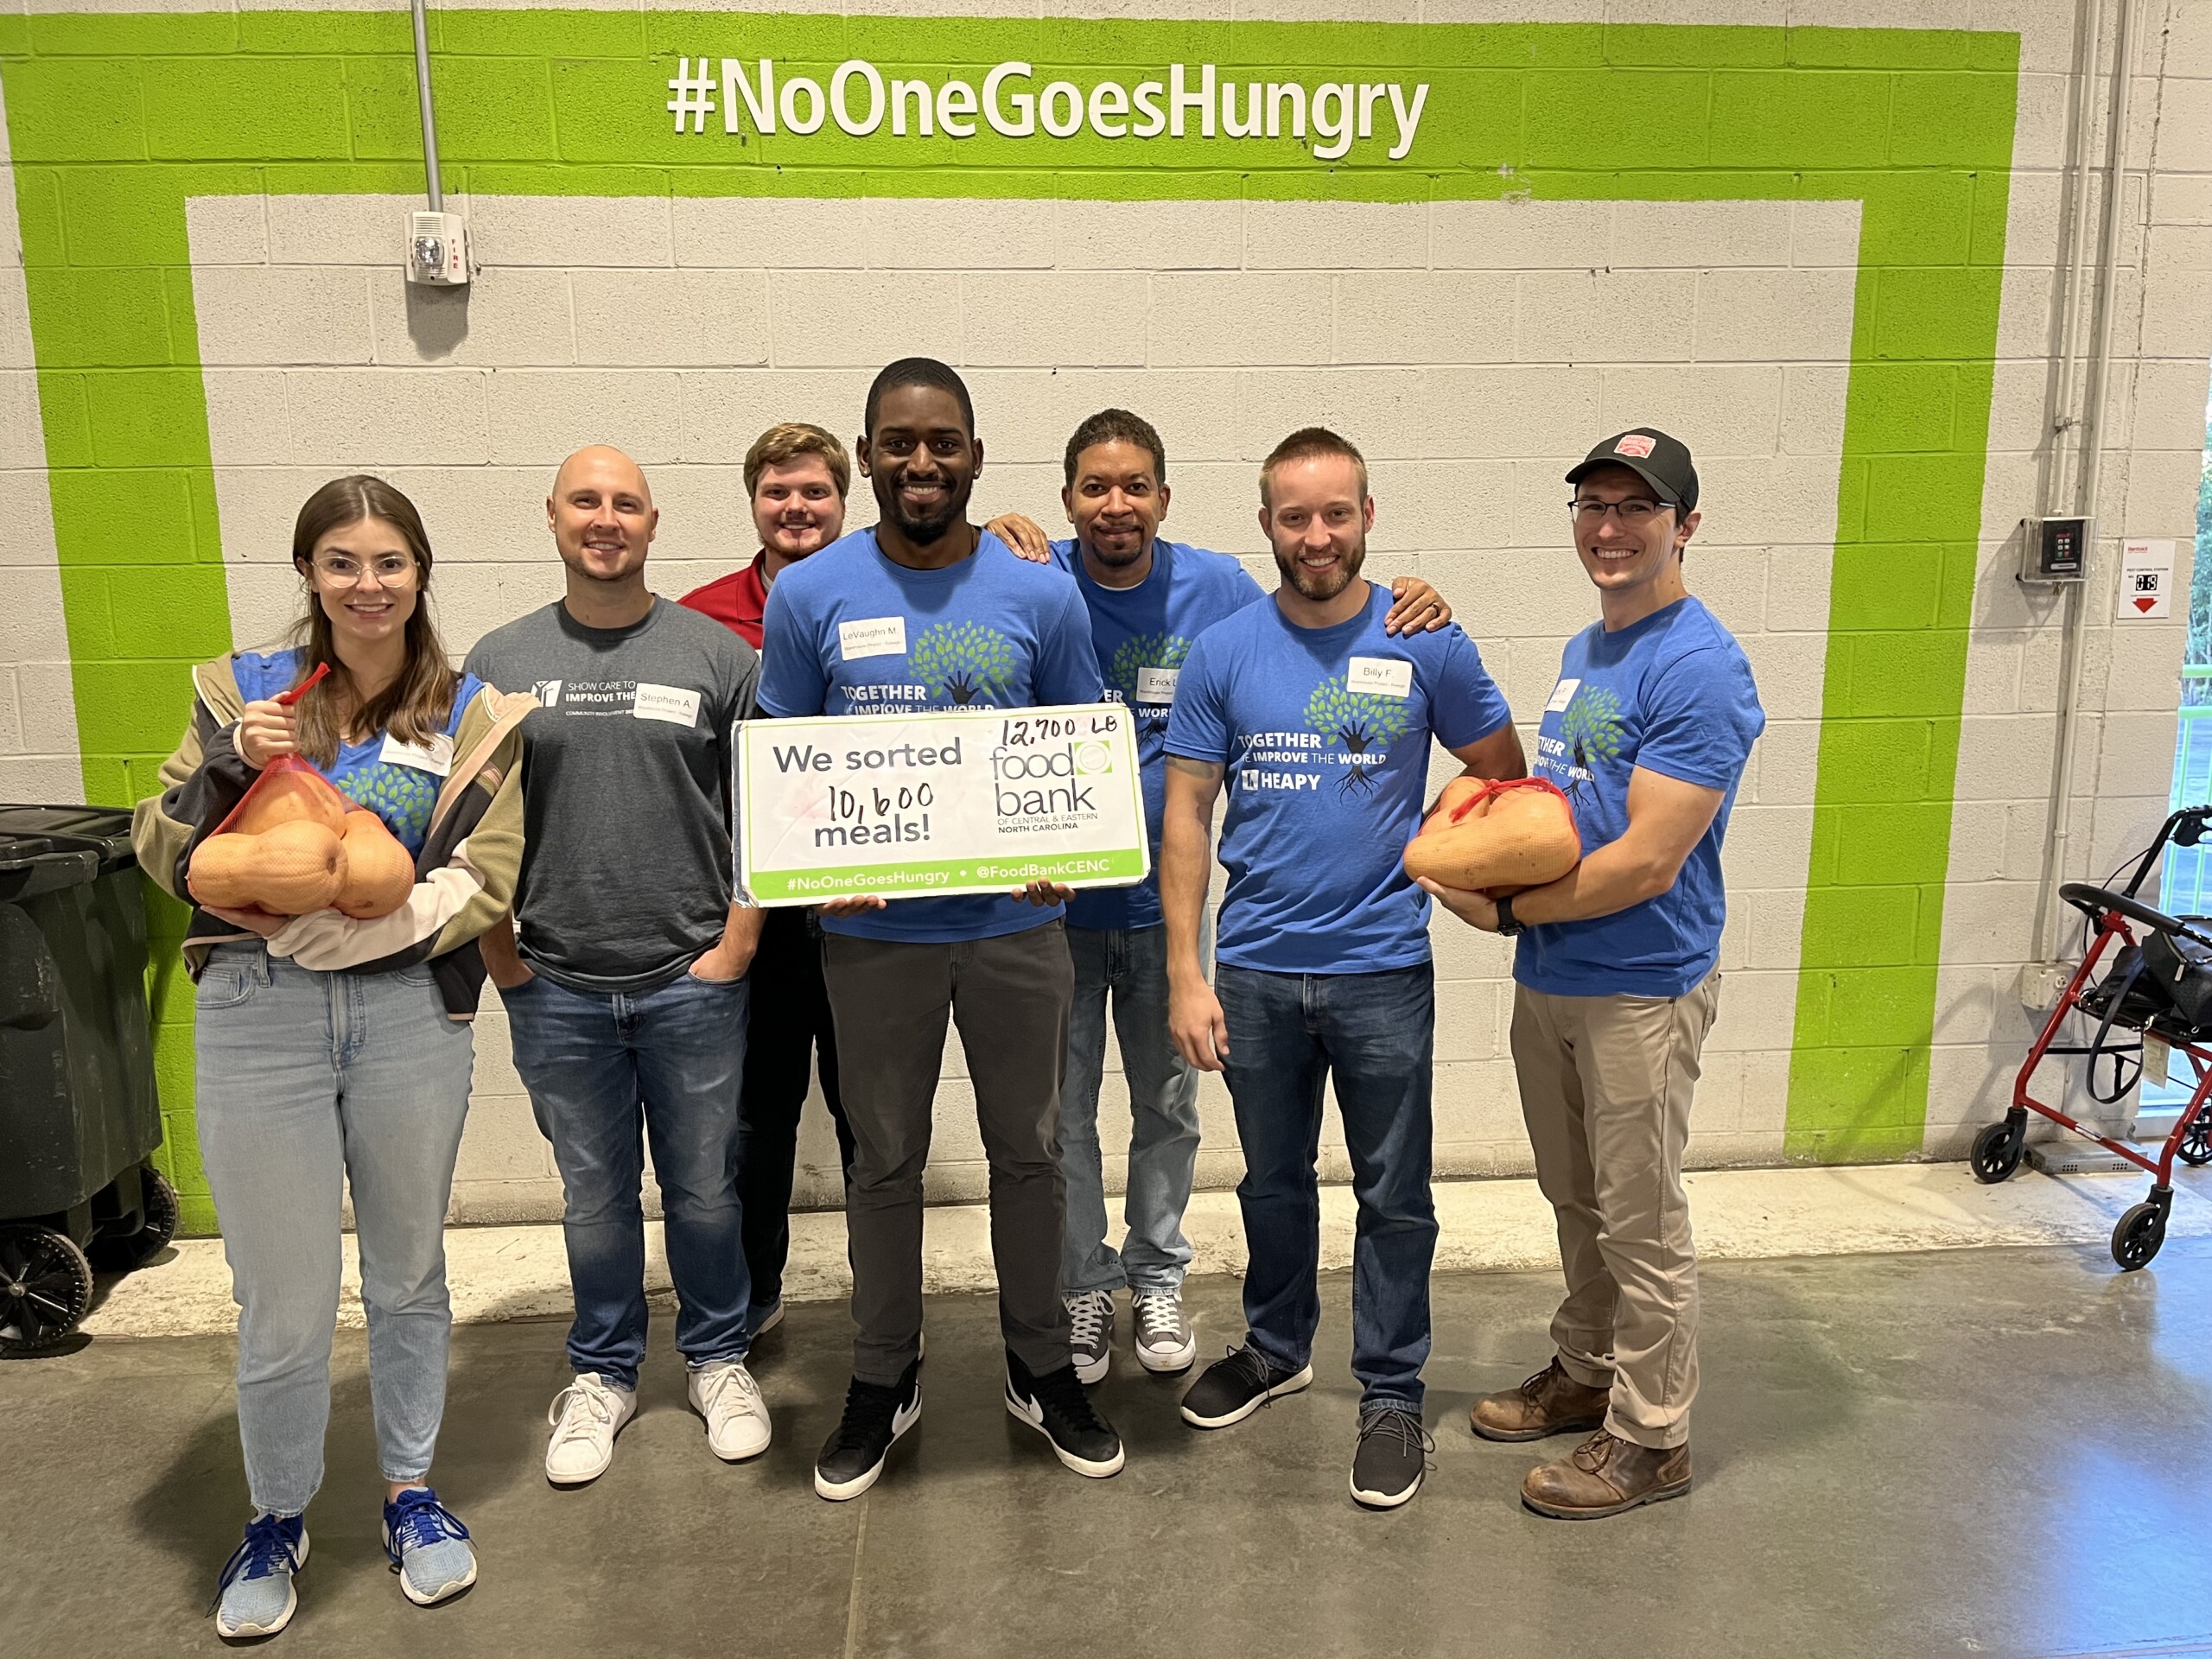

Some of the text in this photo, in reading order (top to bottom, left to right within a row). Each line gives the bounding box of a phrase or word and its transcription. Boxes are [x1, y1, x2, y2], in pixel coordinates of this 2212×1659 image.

[667, 57, 1430, 159] #NoOneGoesHungry
[2137, 575, 2157, 590] 019
[842, 628, 886, 640] LeVaughn
[1363, 667, 1383, 679] Billy
[568, 680, 636, 691] SHOW CARE TO
[1149, 677, 1171, 687] Erick
[565, 691, 636, 702] IMPROVE THE
[640, 692, 681, 705] Stephen
[841, 684, 927, 701] TOGETHER
[1138, 708, 1170, 718] WOR
[1090, 715, 1117, 734] LB
[1237, 732, 1322, 749] TOGETHER
[772, 736, 962, 772] We sorted
[989, 742, 1075, 780] food
[1252, 751, 1308, 764] IMPROVE
[1311, 753, 1335, 765] THE
[1338, 753, 1387, 766] WORLD
[1549, 758, 1568, 775] THE
[1261, 772, 1321, 790] HEAPY
[828, 782, 934, 824] 10,600
[995, 778, 1096, 817] bank
[997, 817, 1009, 826] OF
[1011, 815, 1049, 825] CENTRAL
[1061, 812, 1098, 822] EASTERN
[815, 813, 931, 848] meals!
[998, 822, 1079, 834] NORTH CAROLINA
[787, 858, 1110, 892] #NoOneGoesHungry @FoodBankCENC
